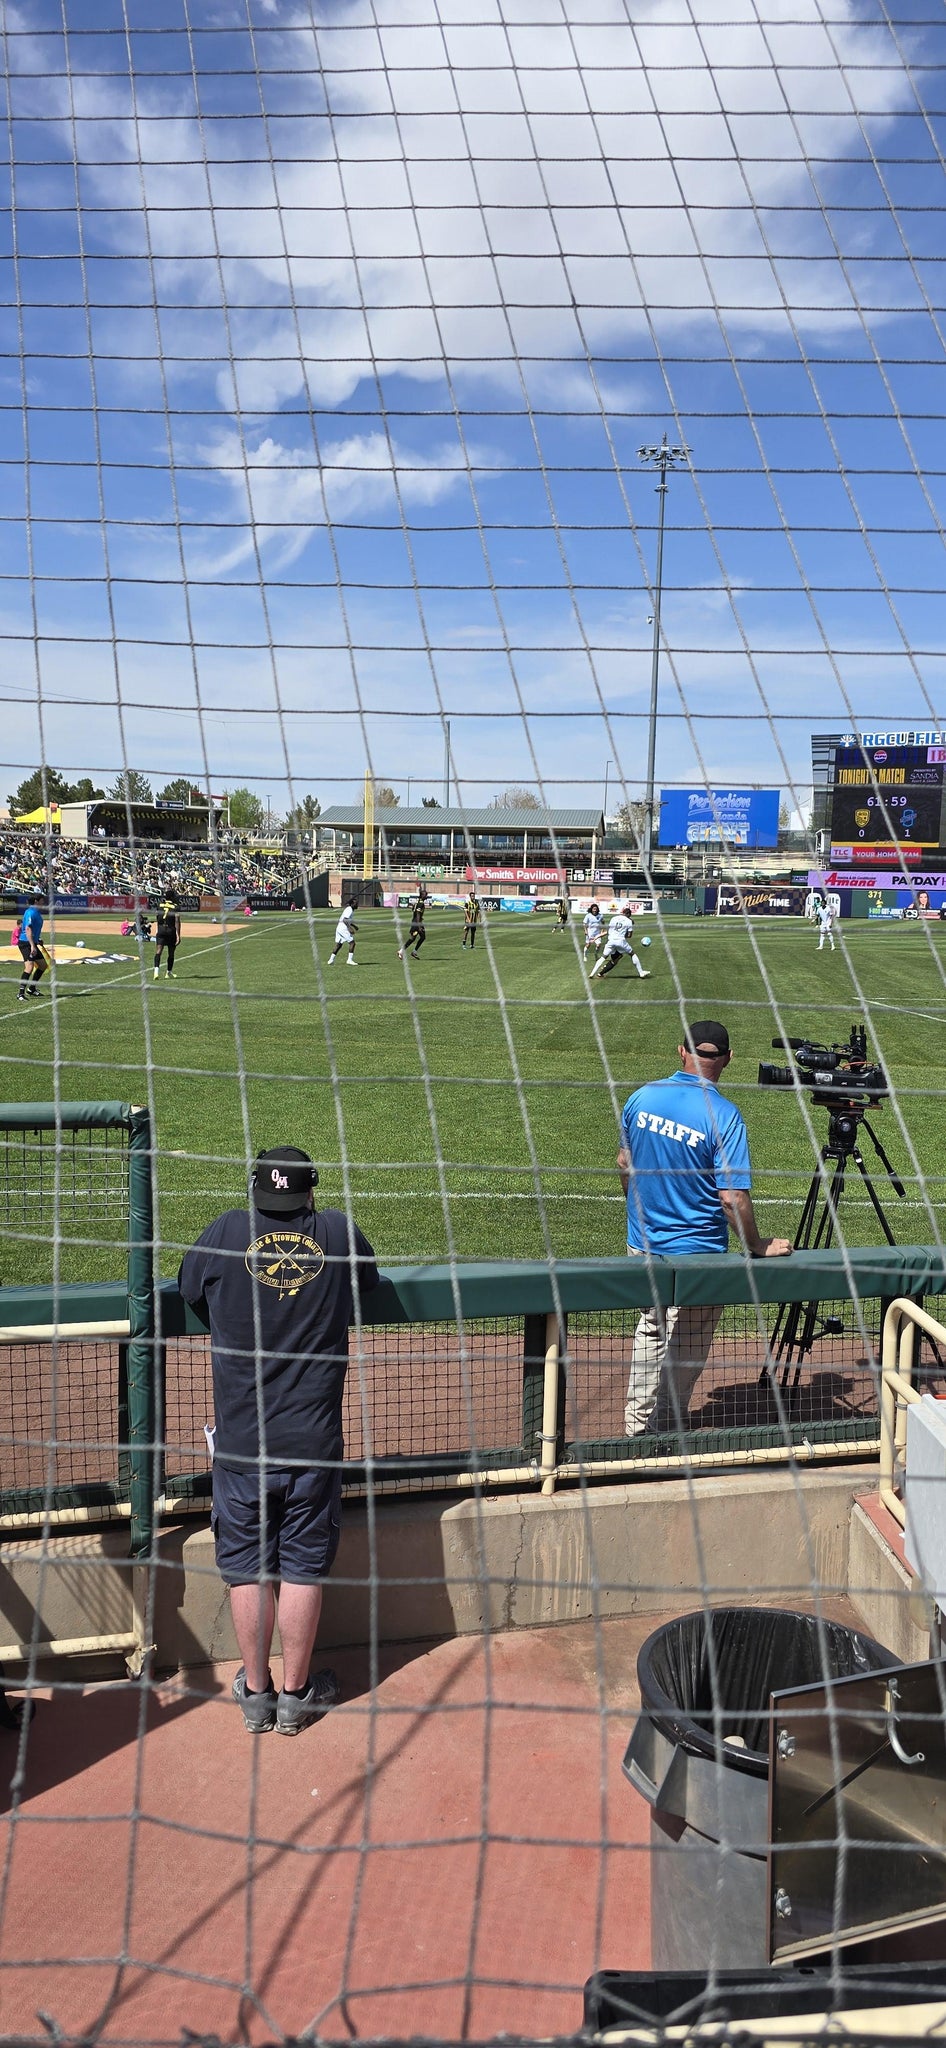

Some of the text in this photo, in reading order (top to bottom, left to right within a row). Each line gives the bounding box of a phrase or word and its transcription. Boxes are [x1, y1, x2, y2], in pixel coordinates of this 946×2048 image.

[861, 732, 908, 746] RGCU
[879, 768, 905, 784] MATCH
[859, 829, 865, 837] 0
[905, 829, 911, 837] 1
[517, 870, 558, 880] Pavilion
[573, 873, 585, 881] 19
[825, 872, 876, 887] Amana
[868, 891, 882, 899] 371
[768, 899, 790, 907] TIME
[637, 1111, 705, 1147] STAFF
[265, 1236, 271, 1244] &
[272, 1234, 301, 1243] Brownie
